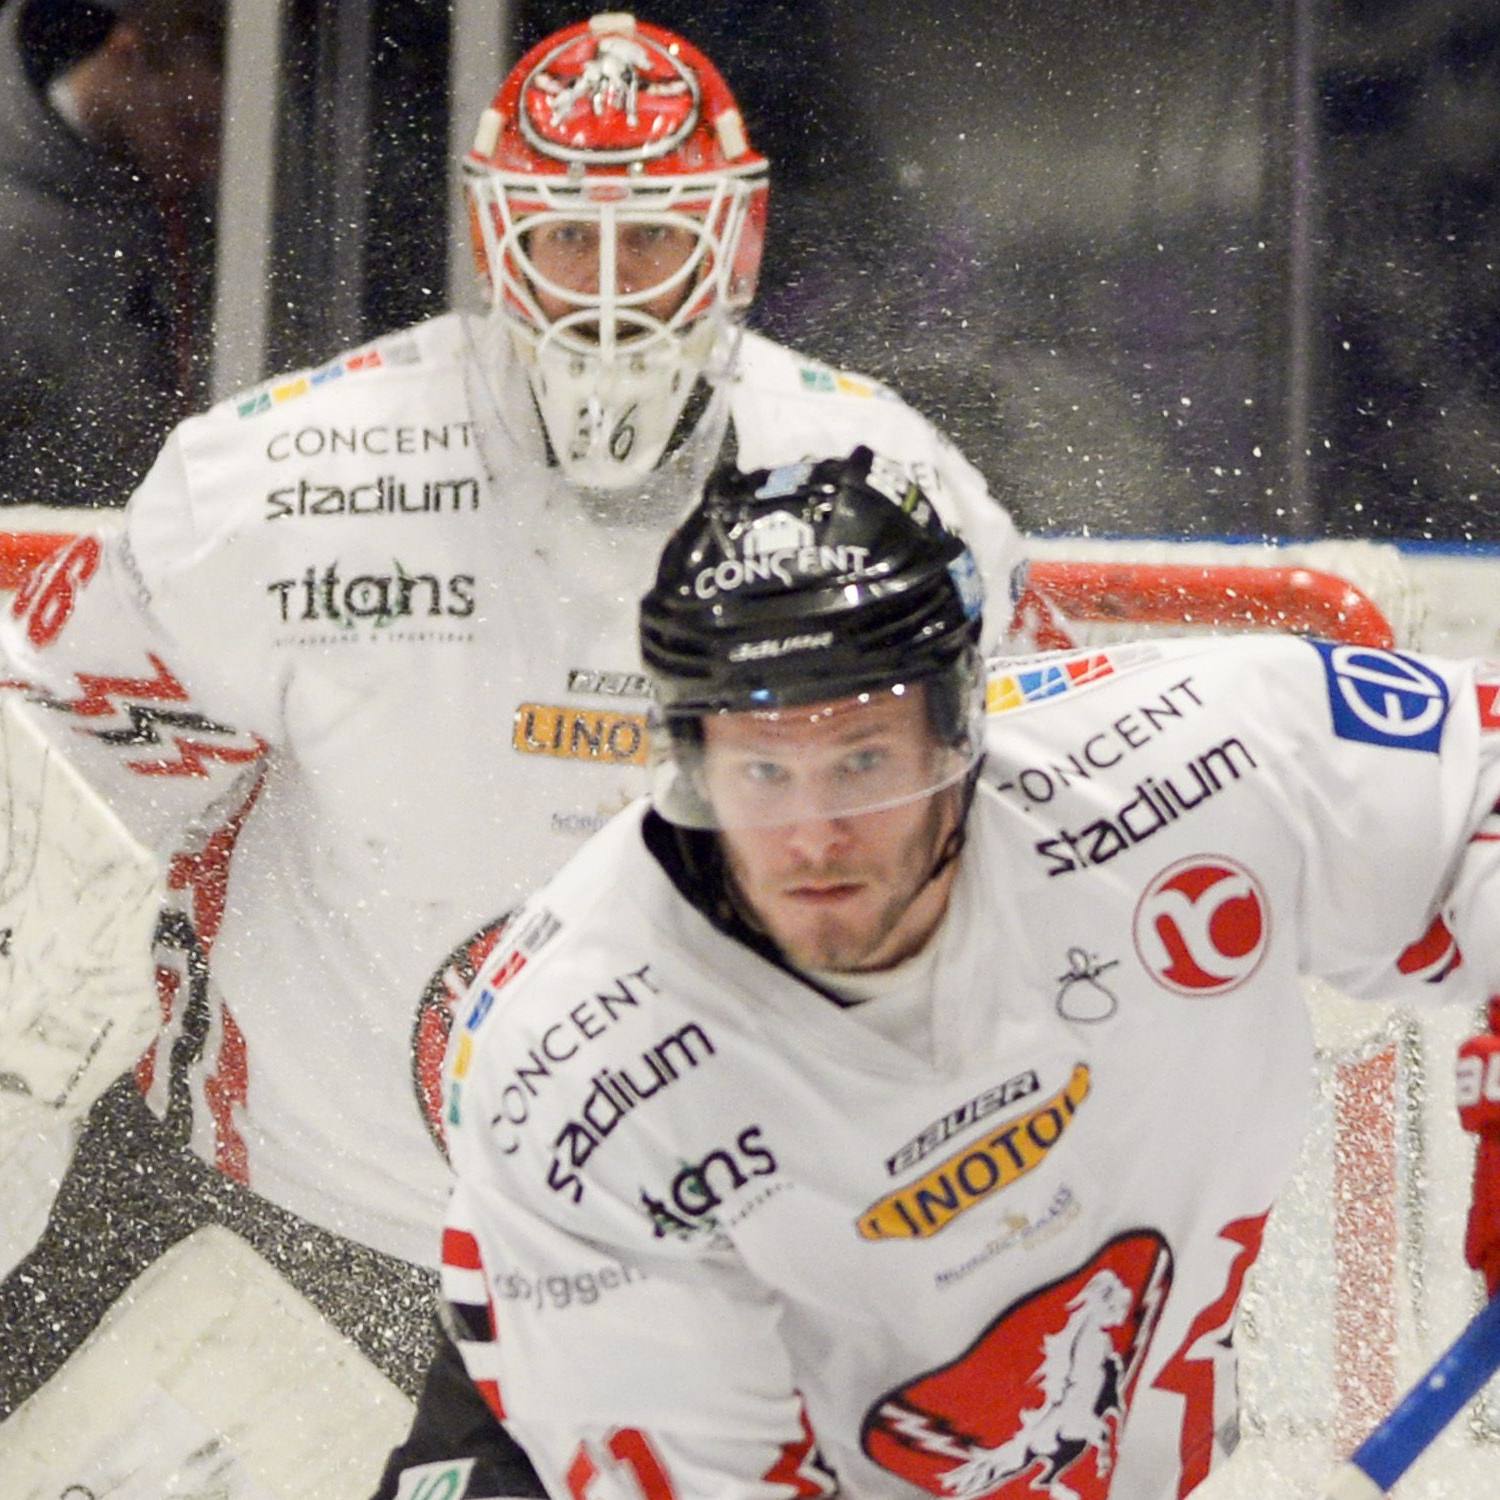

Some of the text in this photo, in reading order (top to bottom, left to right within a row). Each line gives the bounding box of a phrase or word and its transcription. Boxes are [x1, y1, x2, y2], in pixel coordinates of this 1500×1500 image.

[266, 421, 477, 462] CONCENT
[266, 476, 480, 520] stadium
[694, 546, 871, 600] CONCENT
[522, 709, 656, 761] LINO
[1034, 737, 1258, 877] stadium
